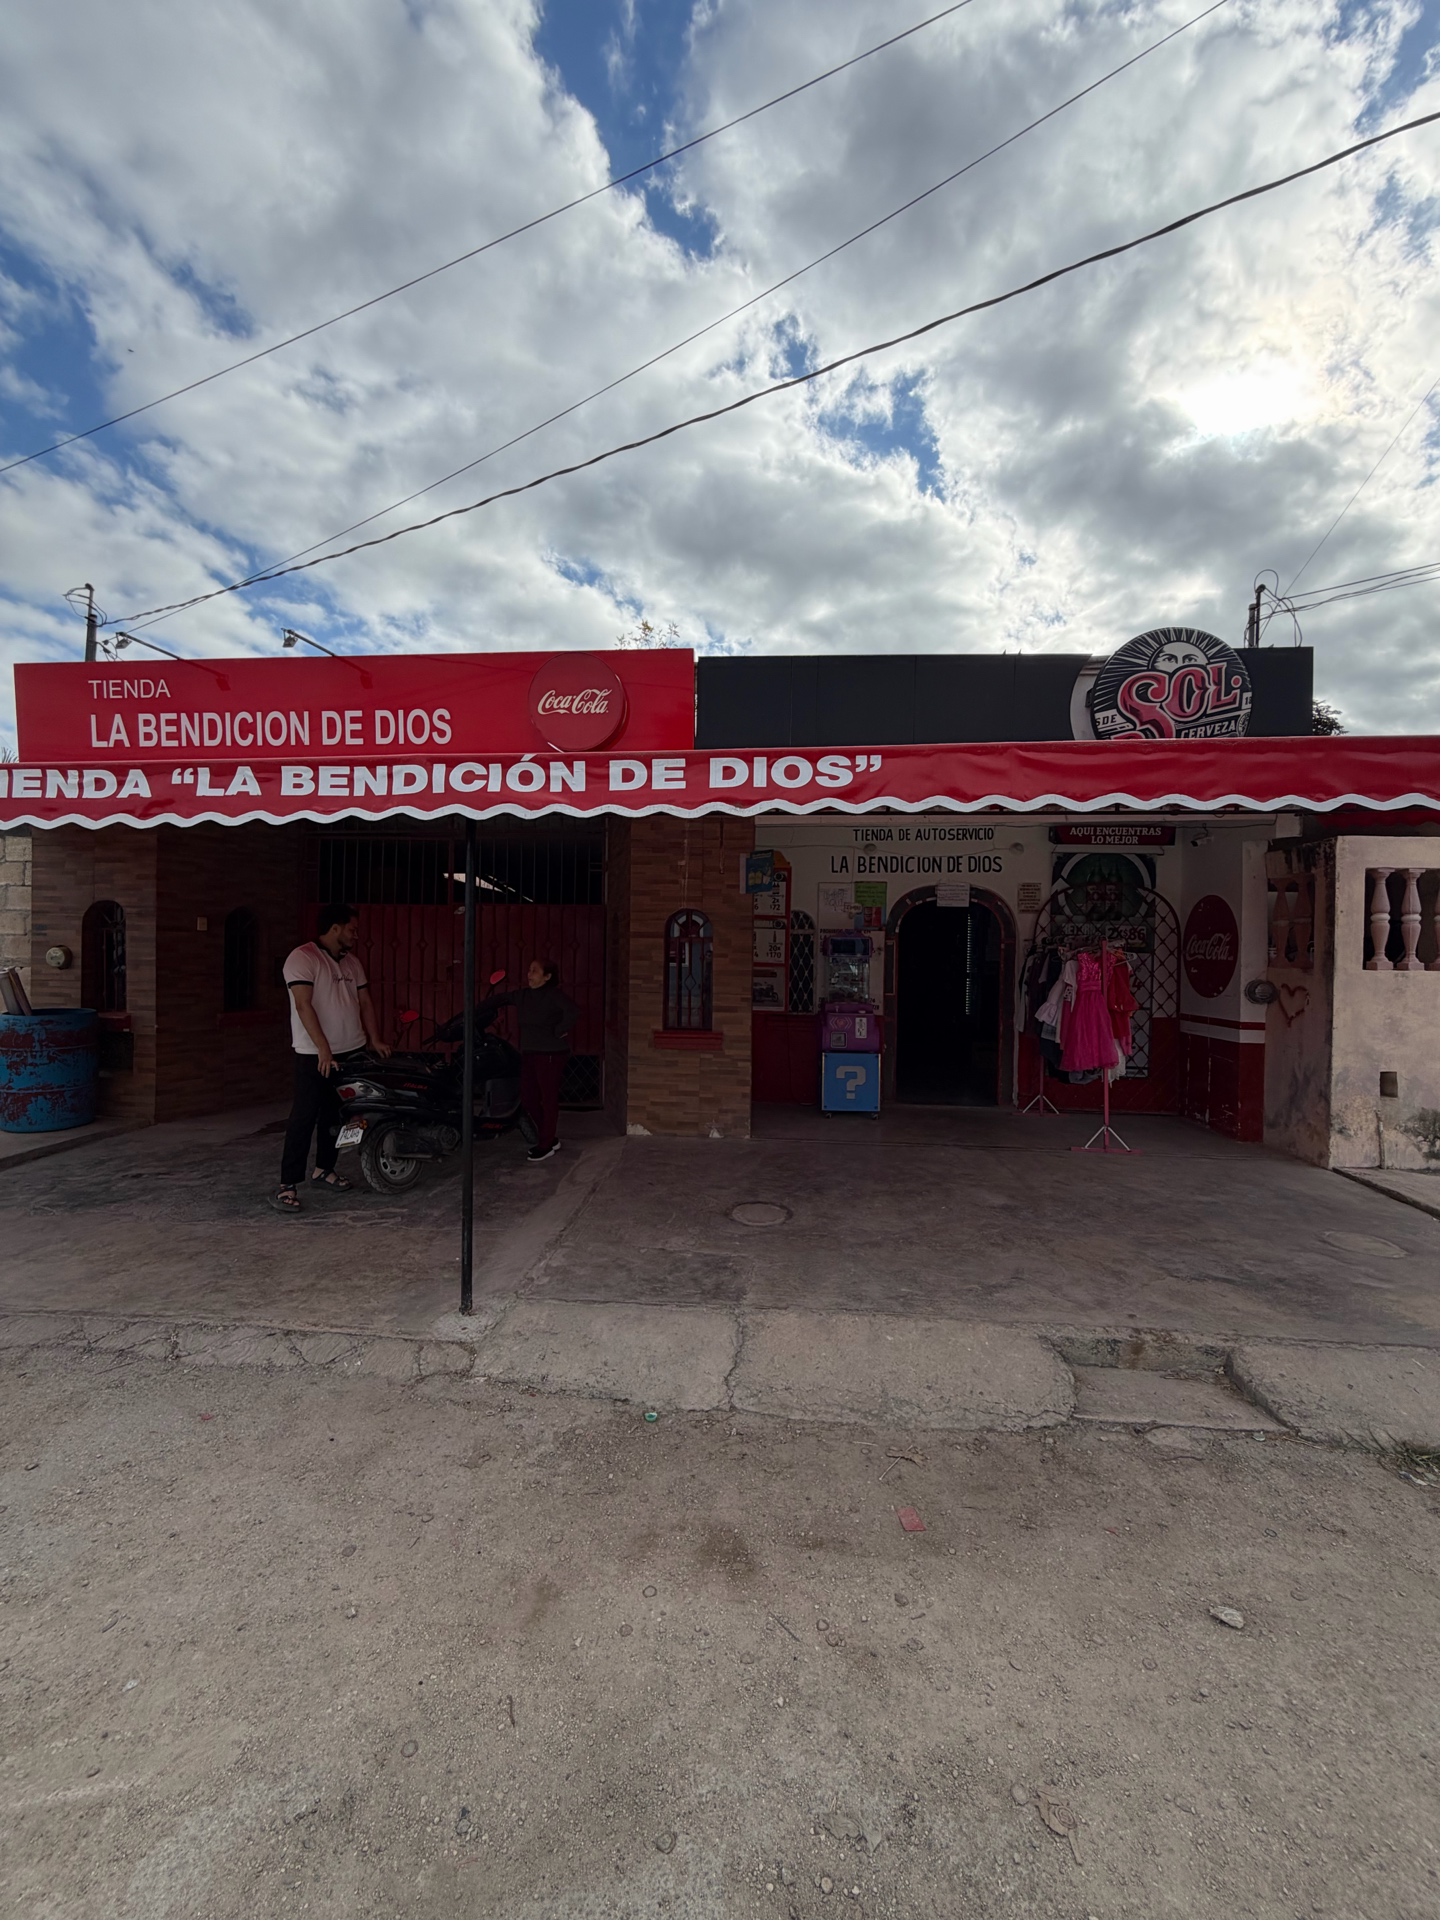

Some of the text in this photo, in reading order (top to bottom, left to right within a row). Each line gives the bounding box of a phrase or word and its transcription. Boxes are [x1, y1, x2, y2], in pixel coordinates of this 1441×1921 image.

[88, 679, 171, 699] TIENDA
[537, 688, 613, 715] Coca-Cola
[90, 708, 453, 748] LA BENDICION DE DIOS
[1095, 714, 1117, 726] SDE
[1181, 719, 1237, 738] CERVEZA
[0, 768, 152, 799] IENDA
[280, 754, 586, 797] BENDICIÓN
[608, 757, 687, 791] DE
[853, 828, 994, 841] TIENDA DE AUTOSERVICIO
[1070, 827, 1162, 836] AQUI ENCUENTRAS
[1091, 836, 1139, 844] LO MEJOR
[831, 856, 1003, 873] LA BENDICION DE DIOS
[1186, 932, 1232, 961] Coca-Cola
